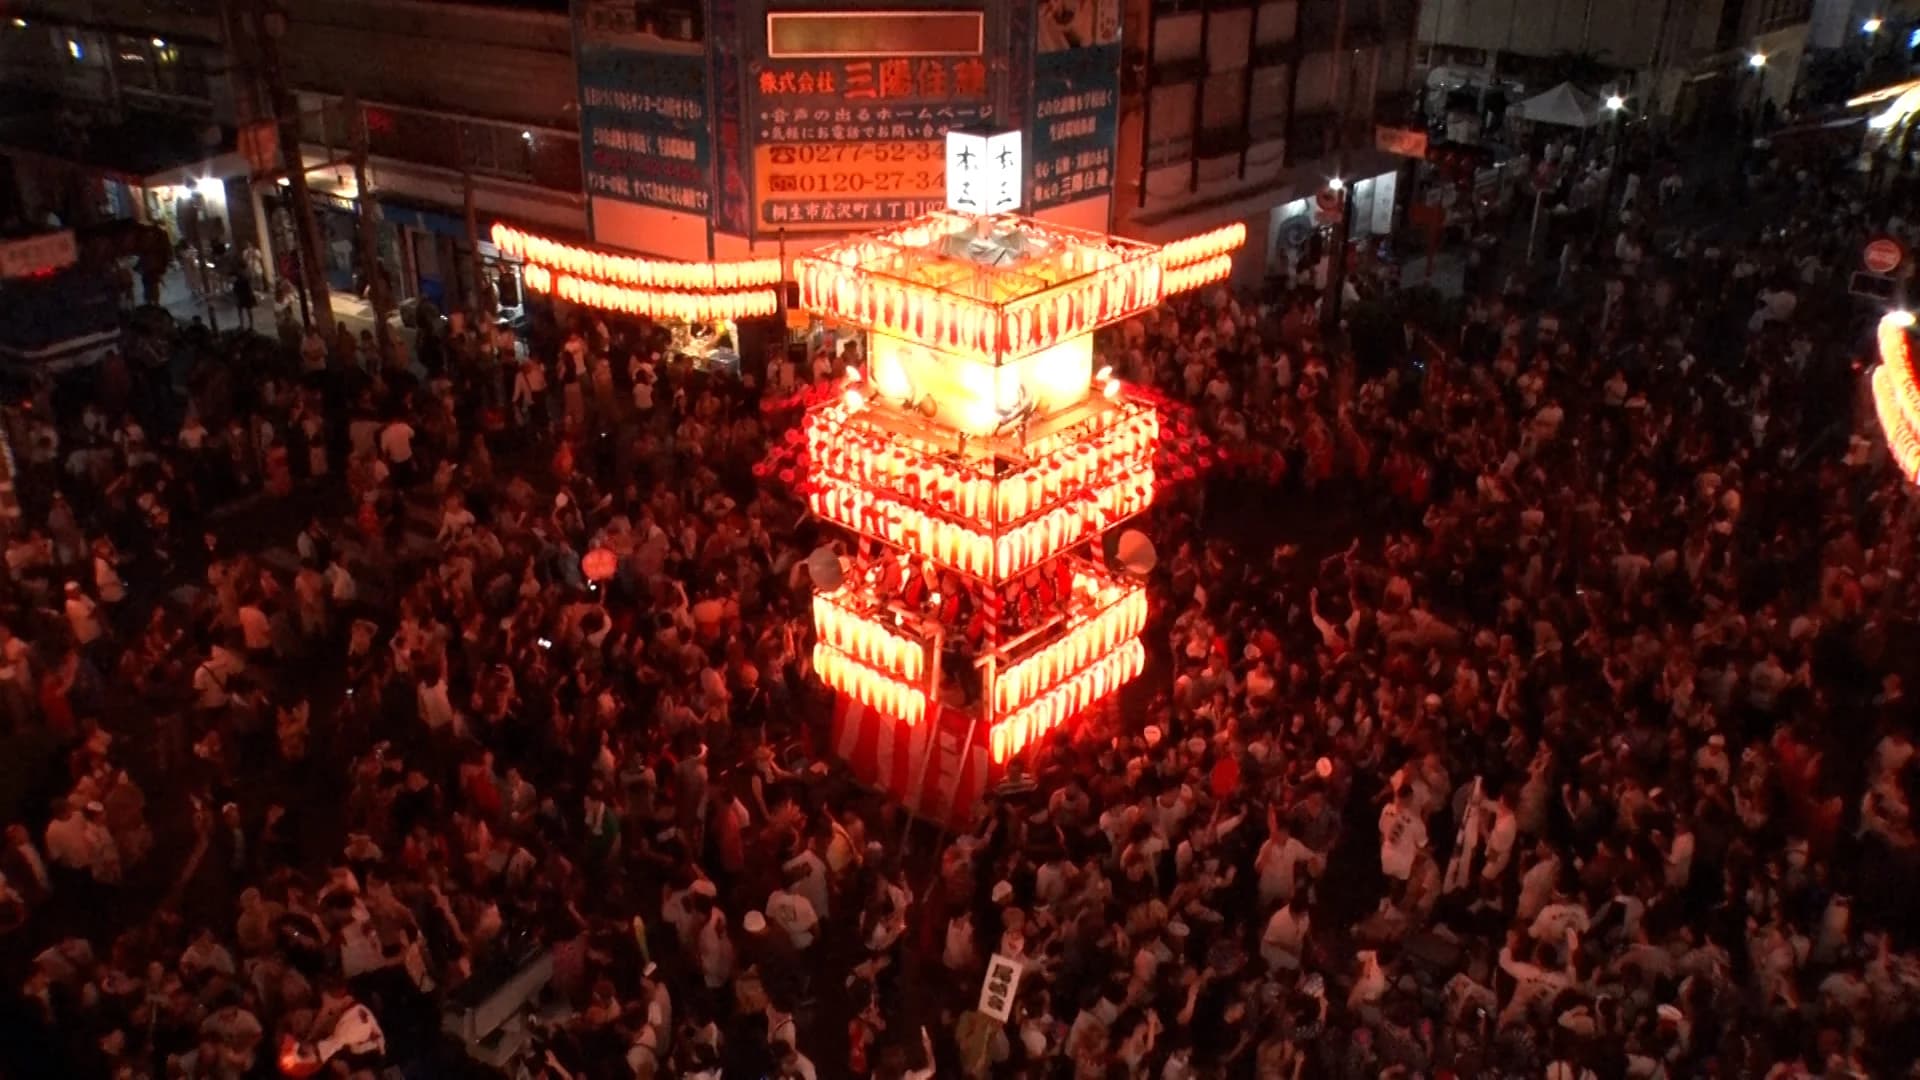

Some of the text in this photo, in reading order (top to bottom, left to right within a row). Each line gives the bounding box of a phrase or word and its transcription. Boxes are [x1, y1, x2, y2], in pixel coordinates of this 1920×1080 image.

[759, 71, 834, 94] 株式会社
[771, 122, 965, 141] 気軽にお電話でお問い合せ
